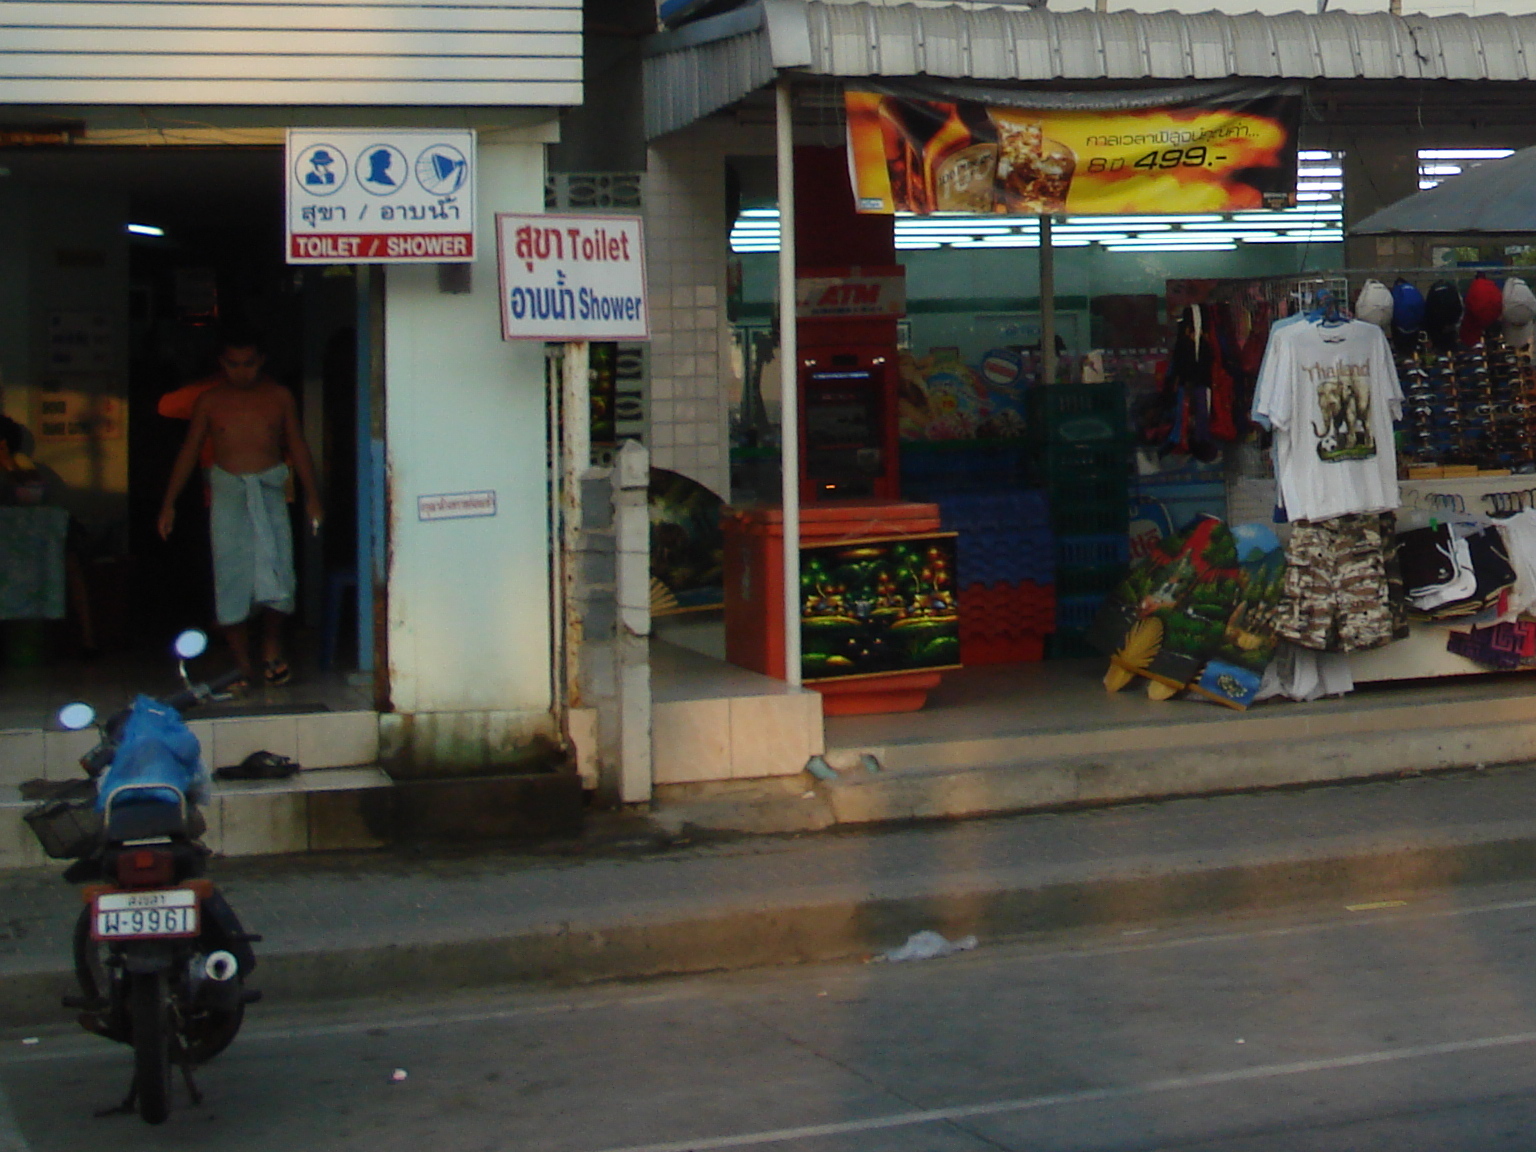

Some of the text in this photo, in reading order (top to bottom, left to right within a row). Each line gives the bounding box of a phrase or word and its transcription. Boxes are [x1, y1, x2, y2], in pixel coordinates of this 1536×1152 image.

[302, 204, 346, 229] สุขา
[381, 197, 460, 221] อาบน้ำ
[296, 236, 362, 257] TOILET
[387, 235, 467, 257] SHOWER
[515, 224, 630, 273] สุขา Toilet
[510, 269, 642, 321] อาบน้ำ Shower
